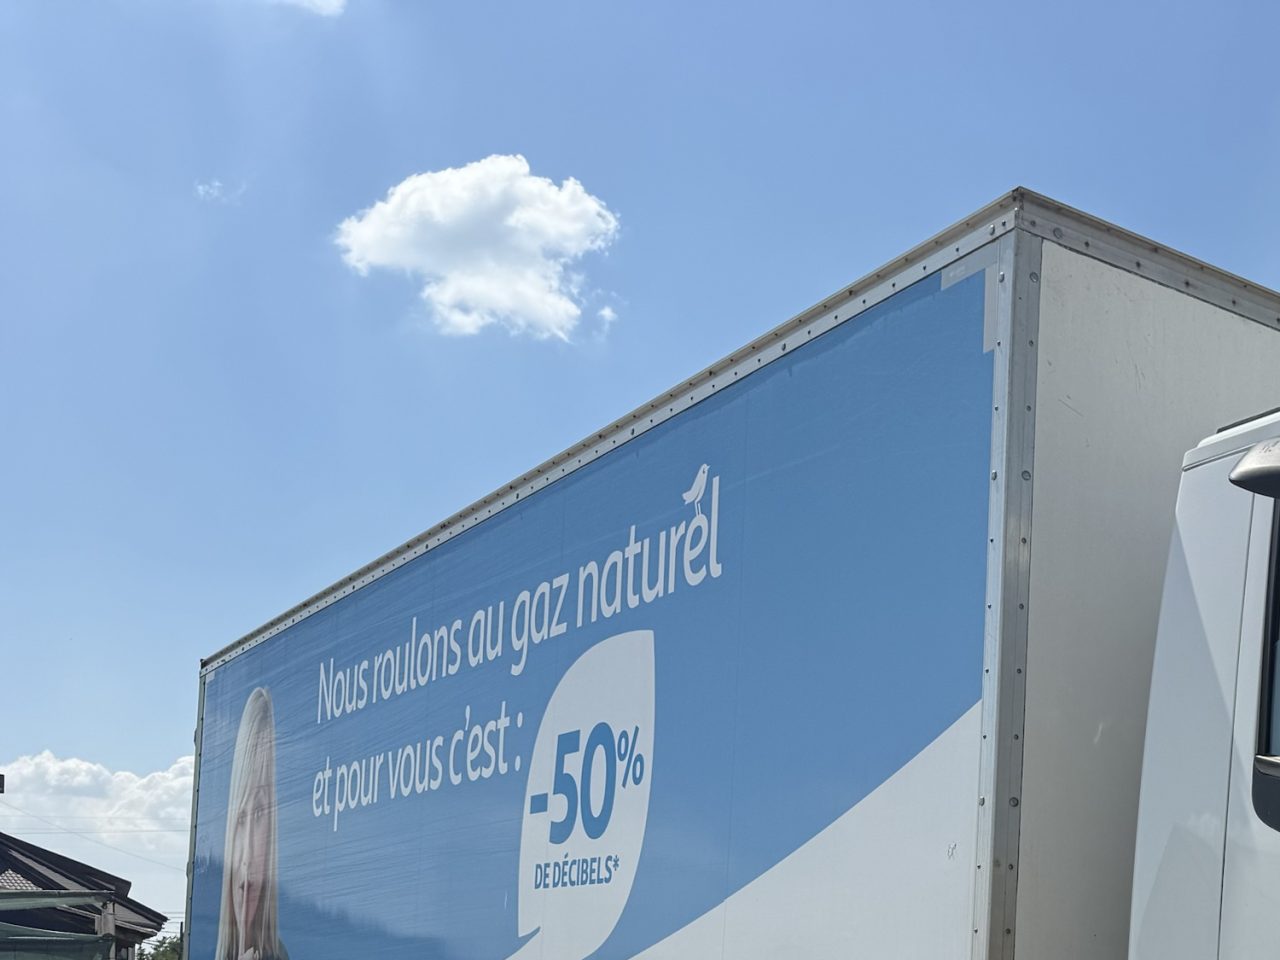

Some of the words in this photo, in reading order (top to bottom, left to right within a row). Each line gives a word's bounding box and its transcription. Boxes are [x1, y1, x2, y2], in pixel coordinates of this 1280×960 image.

[317, 657, 369, 724] Nous
[372, 617, 463, 703] roulons
[467, 600, 505, 668] au
[510, 572, 570, 677] gaz
[577, 475, 723, 628] naturel
[312, 755, 332, 817] et
[333, 747, 384, 832] pour
[388, 735, 445, 800] vous
[449, 700, 510, 786] c'est
[529, 721, 645, 845] -50%
[534, 862, 551, 890] DE
